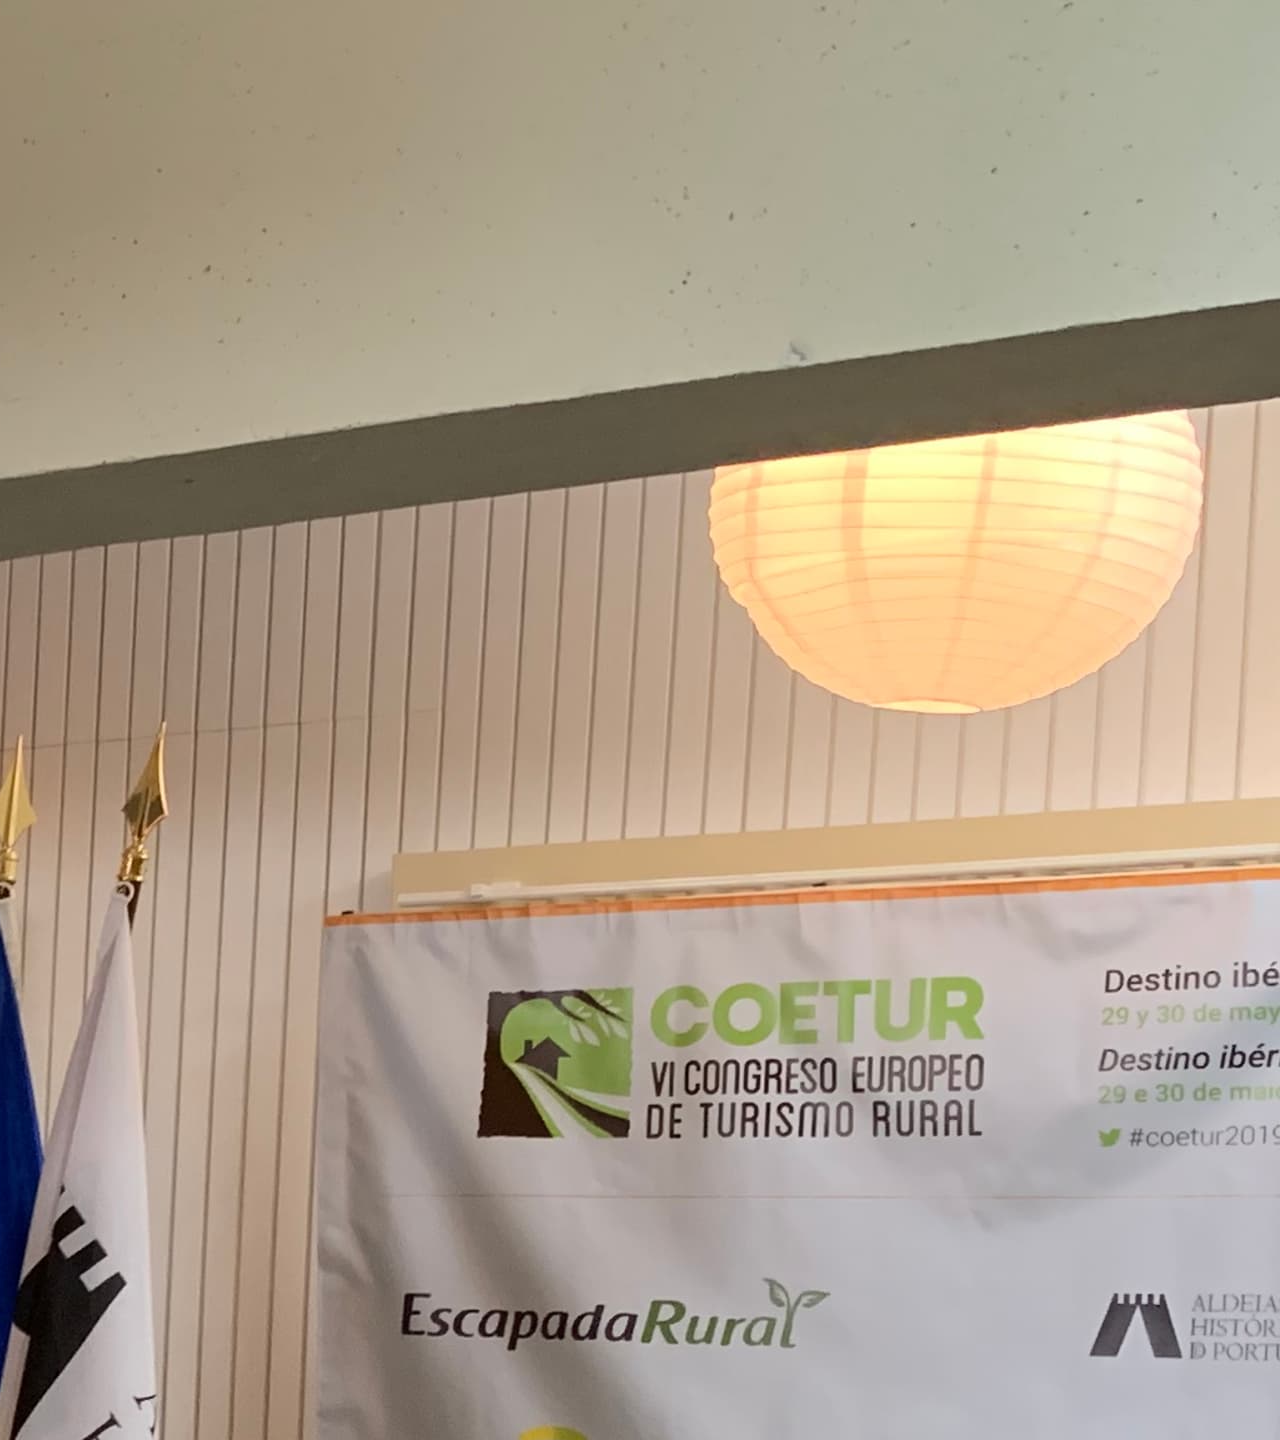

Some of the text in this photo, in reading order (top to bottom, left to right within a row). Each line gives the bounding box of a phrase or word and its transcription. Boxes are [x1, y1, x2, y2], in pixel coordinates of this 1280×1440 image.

[1104, 964, 1221, 993] Destino
[650, 976, 985, 1047] COETUR
[1101, 1005, 1129, 1026] 29
[1136, 1009, 1149, 1029] y
[1156, 1004, 1185, 1023] 30
[1193, 1003, 1221, 1023] de
[651, 1054, 985, 1097] VI CONGRESO EUROPEO
[1098, 1046, 1210, 1072] Destino
[1098, 1084, 1127, 1104] 29
[1134, 1088, 1148, 1103] e
[1155, 1083, 1185, 1102] 30
[1193, 1082, 1222, 1101] de
[646, 1099, 983, 1139] DE TURISMO RURAL
[401, 1278, 830, 1351] EscapadaRural
